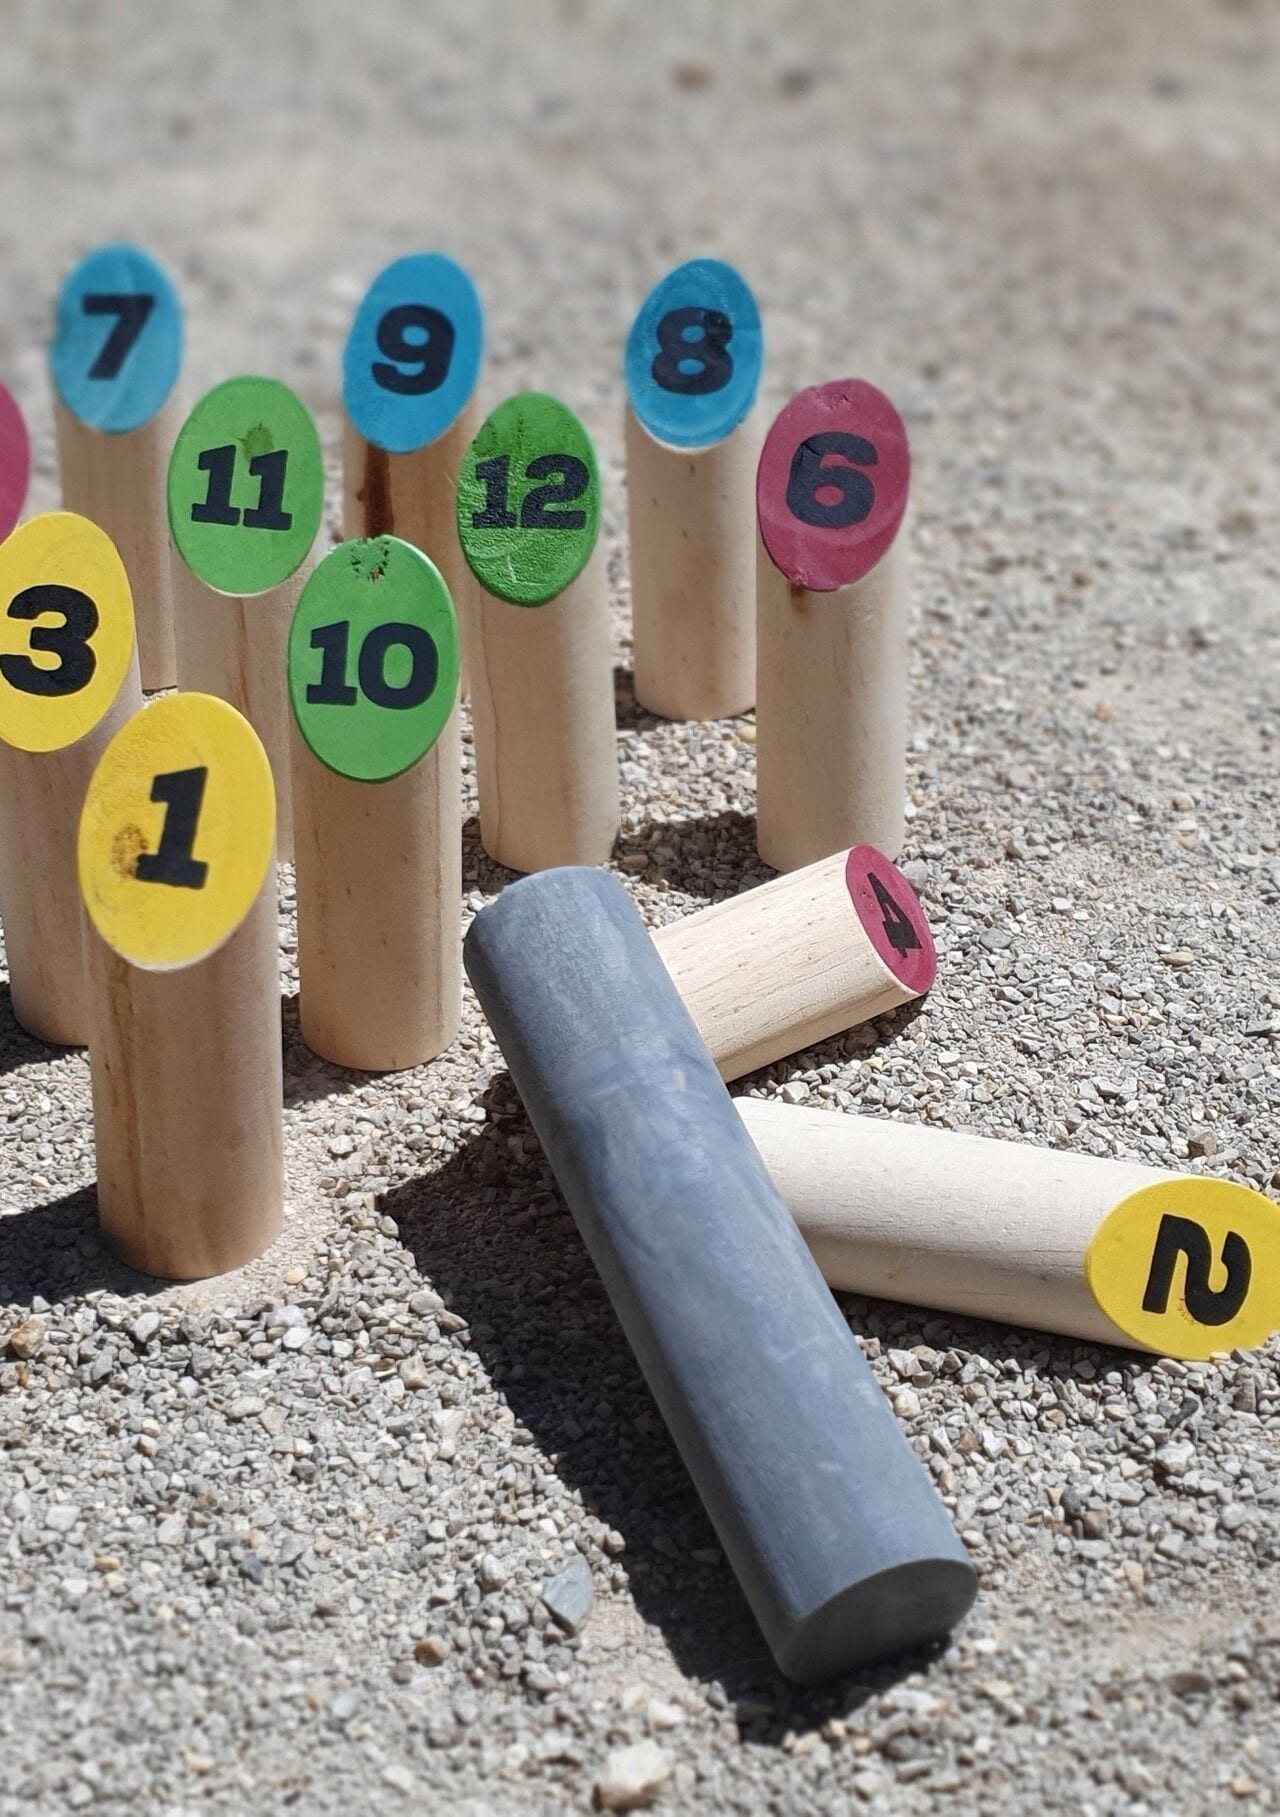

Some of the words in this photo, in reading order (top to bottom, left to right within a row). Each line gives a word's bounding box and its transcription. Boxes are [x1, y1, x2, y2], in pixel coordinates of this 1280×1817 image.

[81, 294, 155, 381] 7
[371, 304, 456, 396] 9
[650, 306, 734, 396] 8
[190, 445, 293, 531] 11
[465, 453, 591, 531] 12
[785, 431, 879, 530] 6
[305, 620, 439, 710] 10
[133, 766, 209, 890] 1
[867, 872, 923, 959] 4
[1142, 1213, 1252, 1327] 2
